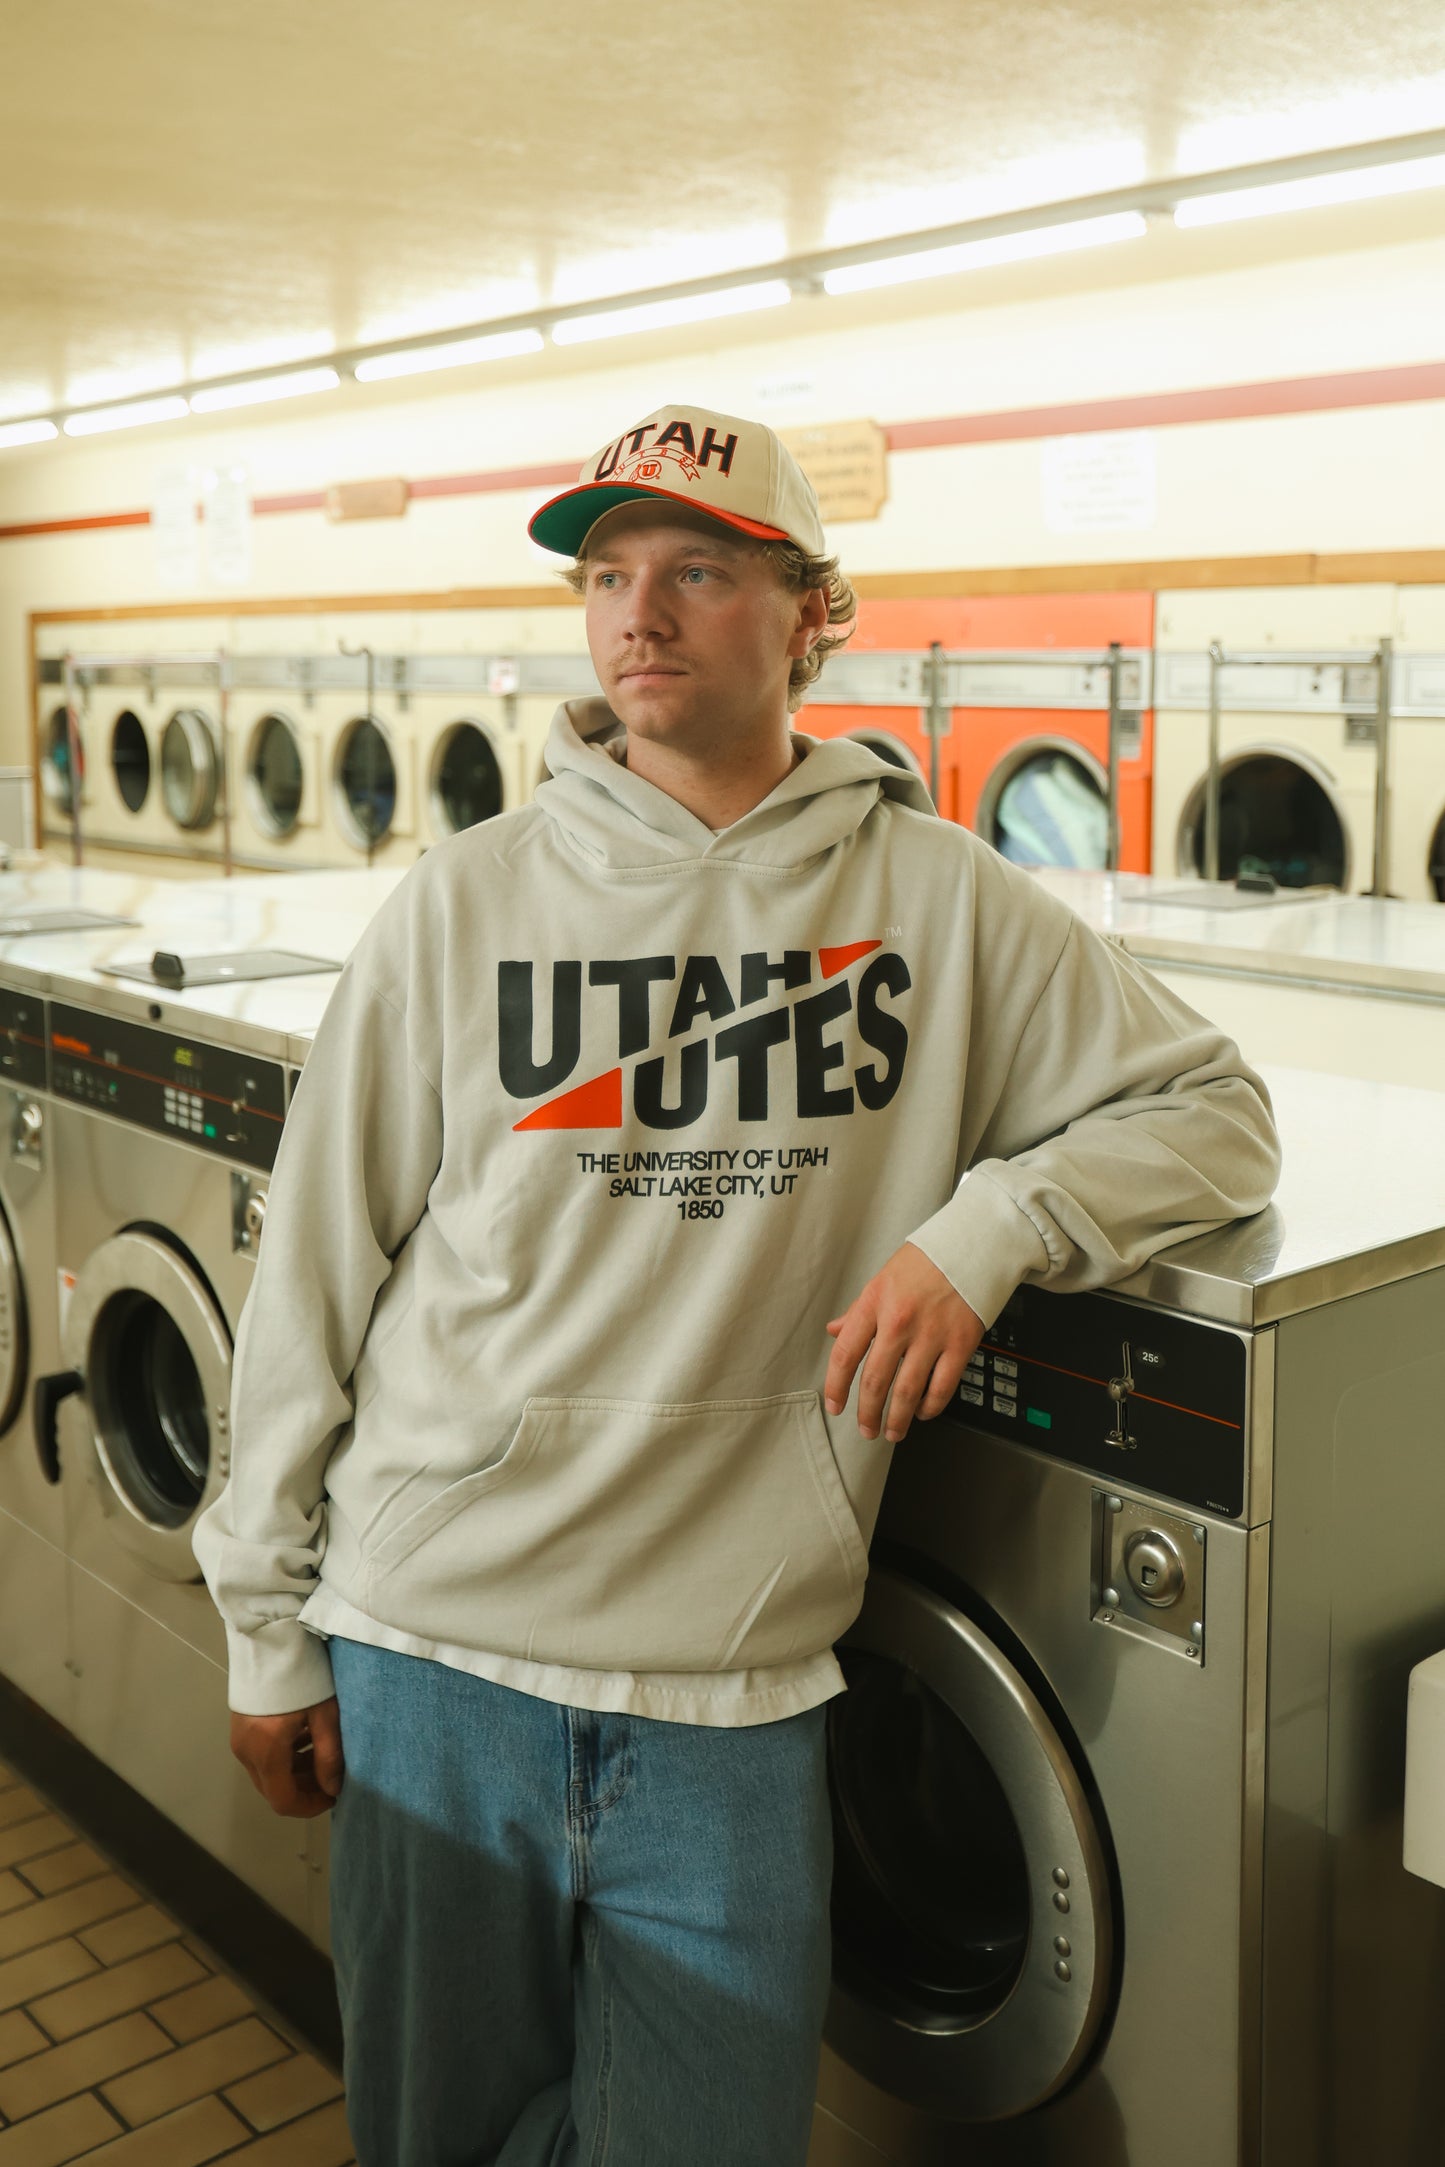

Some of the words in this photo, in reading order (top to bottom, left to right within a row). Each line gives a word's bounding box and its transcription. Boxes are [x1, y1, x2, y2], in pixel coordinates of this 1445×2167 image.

[594, 421, 738, 482] UTAH
[642, 464, 657, 477] U
[884, 925, 902, 939] TM
[498, 951, 811, 1099] UTAH
[633, 953, 911, 1130] UTES
[577, 1152, 620, 1173] THE
[623, 1150, 740, 1172] UNIVERSITY
[743, 1149, 773, 1170] OF
[778, 1147, 829, 1169] UTAH
[609, 1177, 657, 1198] SALT
[659, 1176, 712, 1197] LAKE
[716, 1175, 764, 1199] CITY,
[771, 1174, 798, 1195] UT
[677, 1199, 724, 1221] 1850
